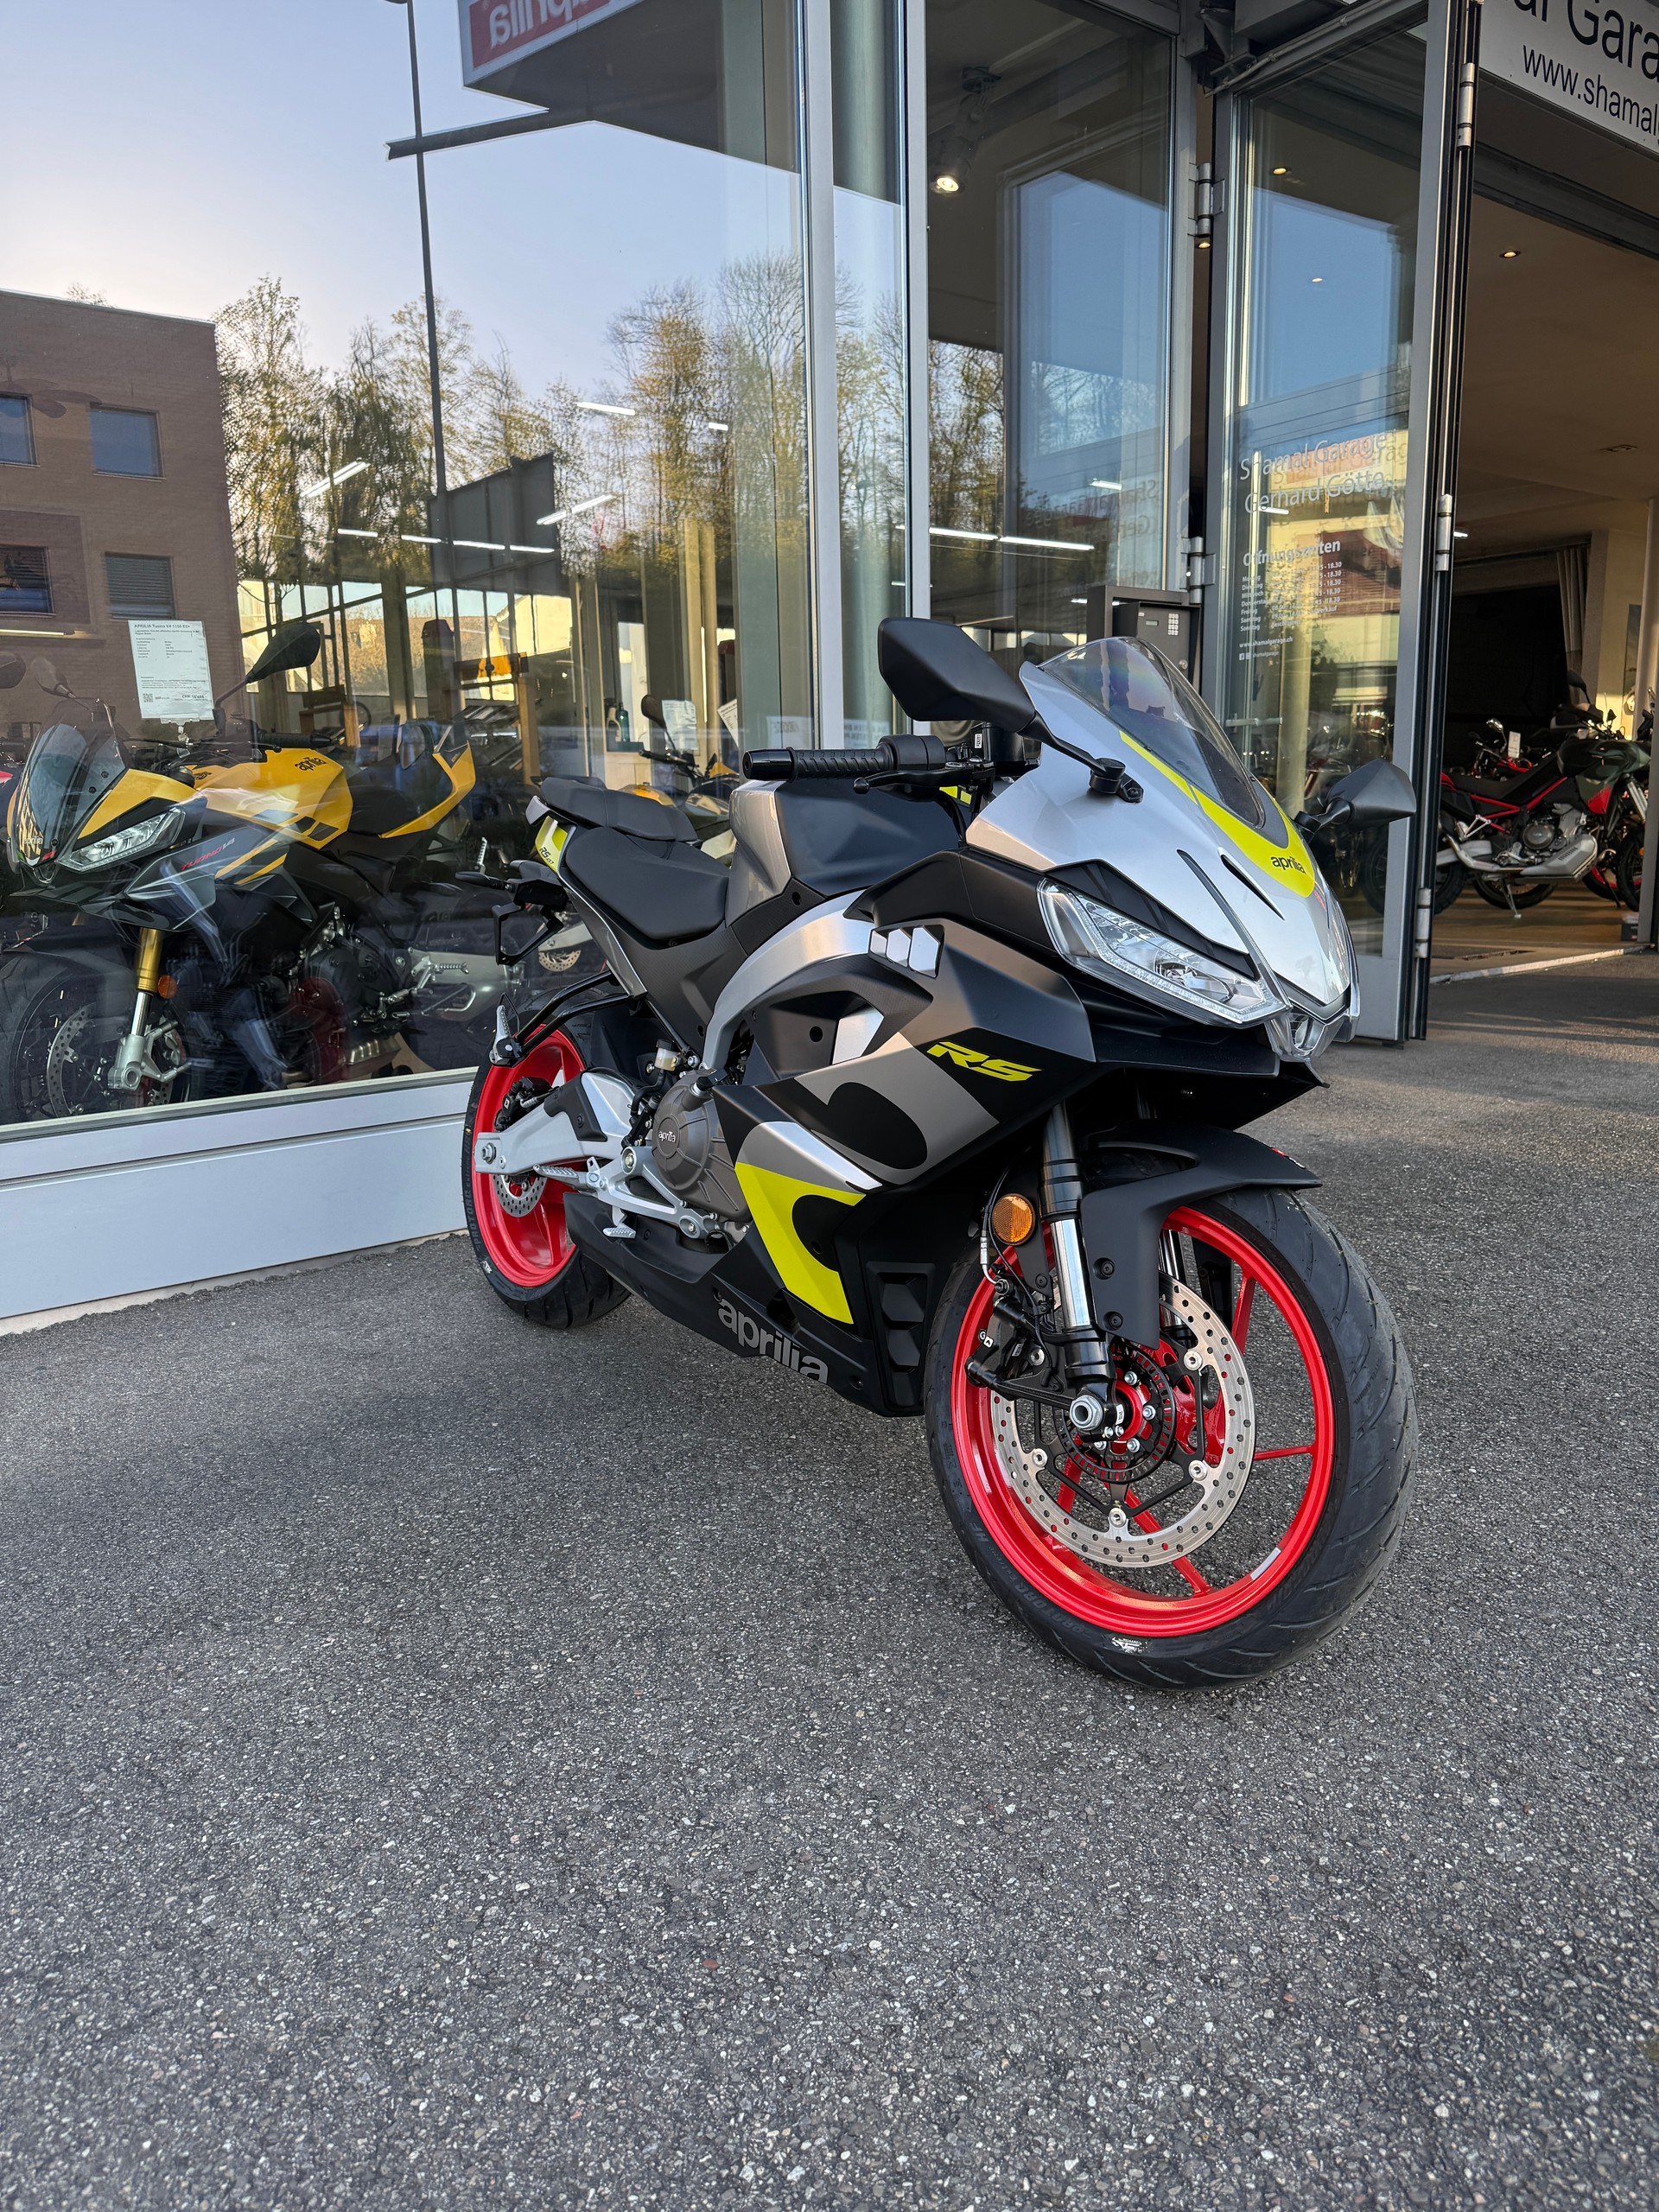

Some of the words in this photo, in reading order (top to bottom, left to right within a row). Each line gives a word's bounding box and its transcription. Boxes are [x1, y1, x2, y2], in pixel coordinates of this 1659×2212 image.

[1523, 45, 1659, 145] www.shamal
[1240, 442, 1308, 480] Samal
[1313, 432, 1388, 463] Garage
[1244, 477, 1320, 514] Gerhard
[1326, 469, 1384, 499] Götte
[1243, 540, 1341, 567] fnungszeiten
[1241, 599, 1269, 608] Donerstag
[1242, 590, 1264, 599] Mittoch
[1239, 636, 1294, 648] wwwshamalgarage.ch
[1270, 854, 1306, 874] aprilia
[925, 1041, 1043, 1082] RS
[658, 1130, 676, 1143] aprilia
[717, 1298, 829, 1384] aprilia
